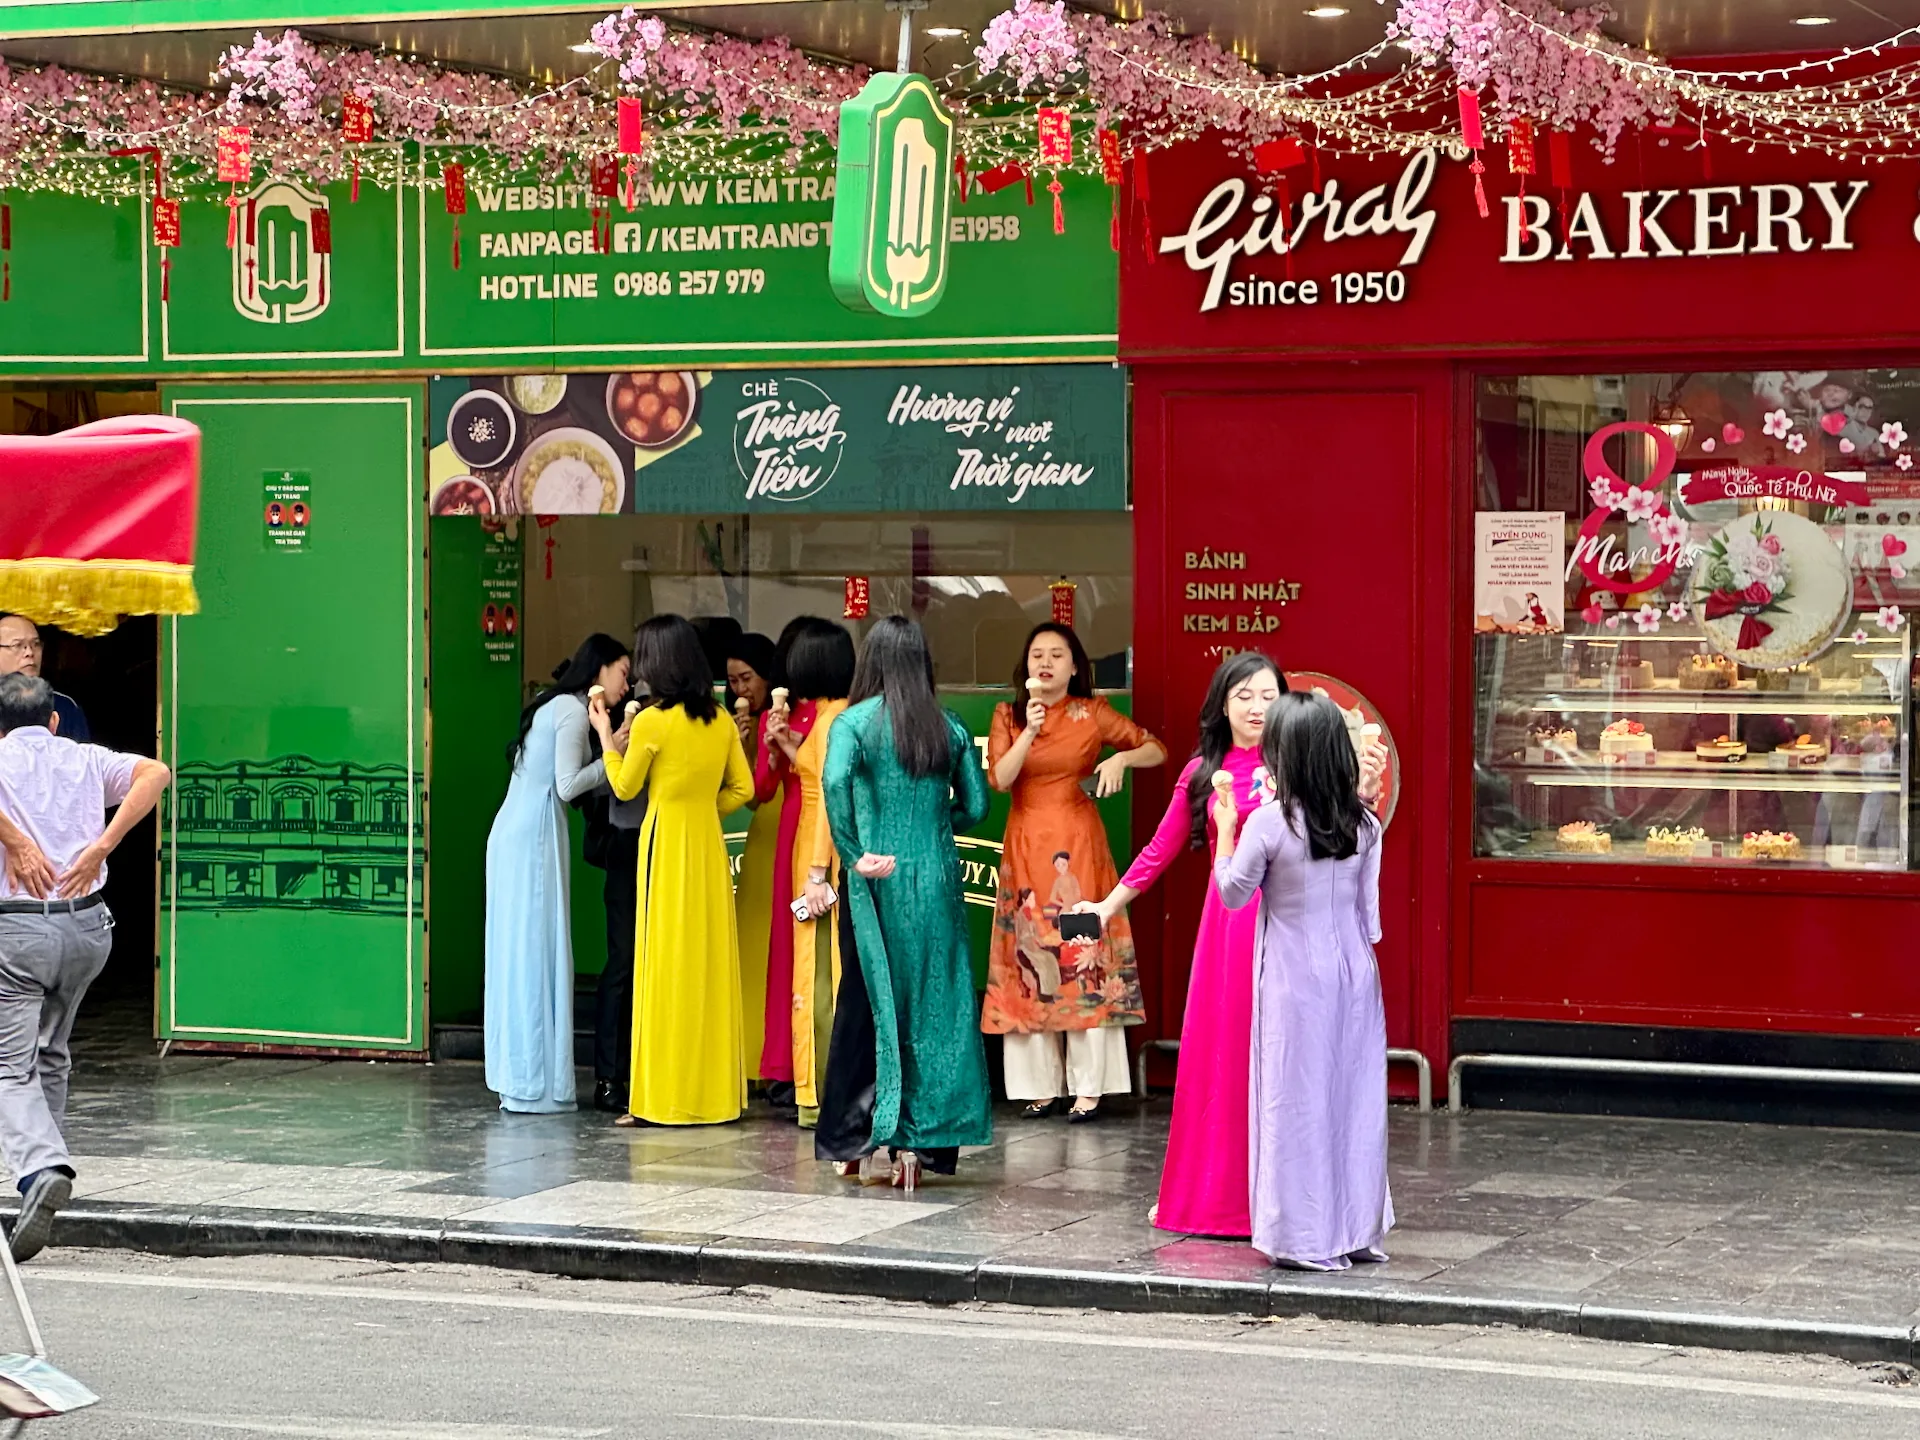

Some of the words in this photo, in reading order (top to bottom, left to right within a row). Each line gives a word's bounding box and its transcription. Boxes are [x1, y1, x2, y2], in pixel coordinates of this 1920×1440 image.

[950, 215, 1020, 242] E1958
[1499, 180, 1869, 262] BAKERY
[480, 273, 598, 300] HOTLINE
[614, 271, 672, 297] 0986
[679, 270, 720, 295] 257
[725, 268, 765, 294] 979
[1229, 274, 1319, 306] since
[1331, 270, 1406, 304] 1950
[742, 379, 779, 397] CHÈ
[737, 400, 847, 453] Tràng
[887, 384, 990, 438] Hương
[745, 444, 822, 500] Tiền
[950, 447, 1019, 491] Thời
[1724, 476, 1764, 498] Quốc
[1766, 477, 1786, 495] Tế
[1786, 470, 1812, 500] Phụ
[1184, 546, 1246, 570] BÁNH
[1185, 582, 1236, 601] SINH
[1243, 578, 1303, 607] NHẬT
[1184, 614, 1229, 633] KEM
[1236, 605, 1281, 634] BẮP
